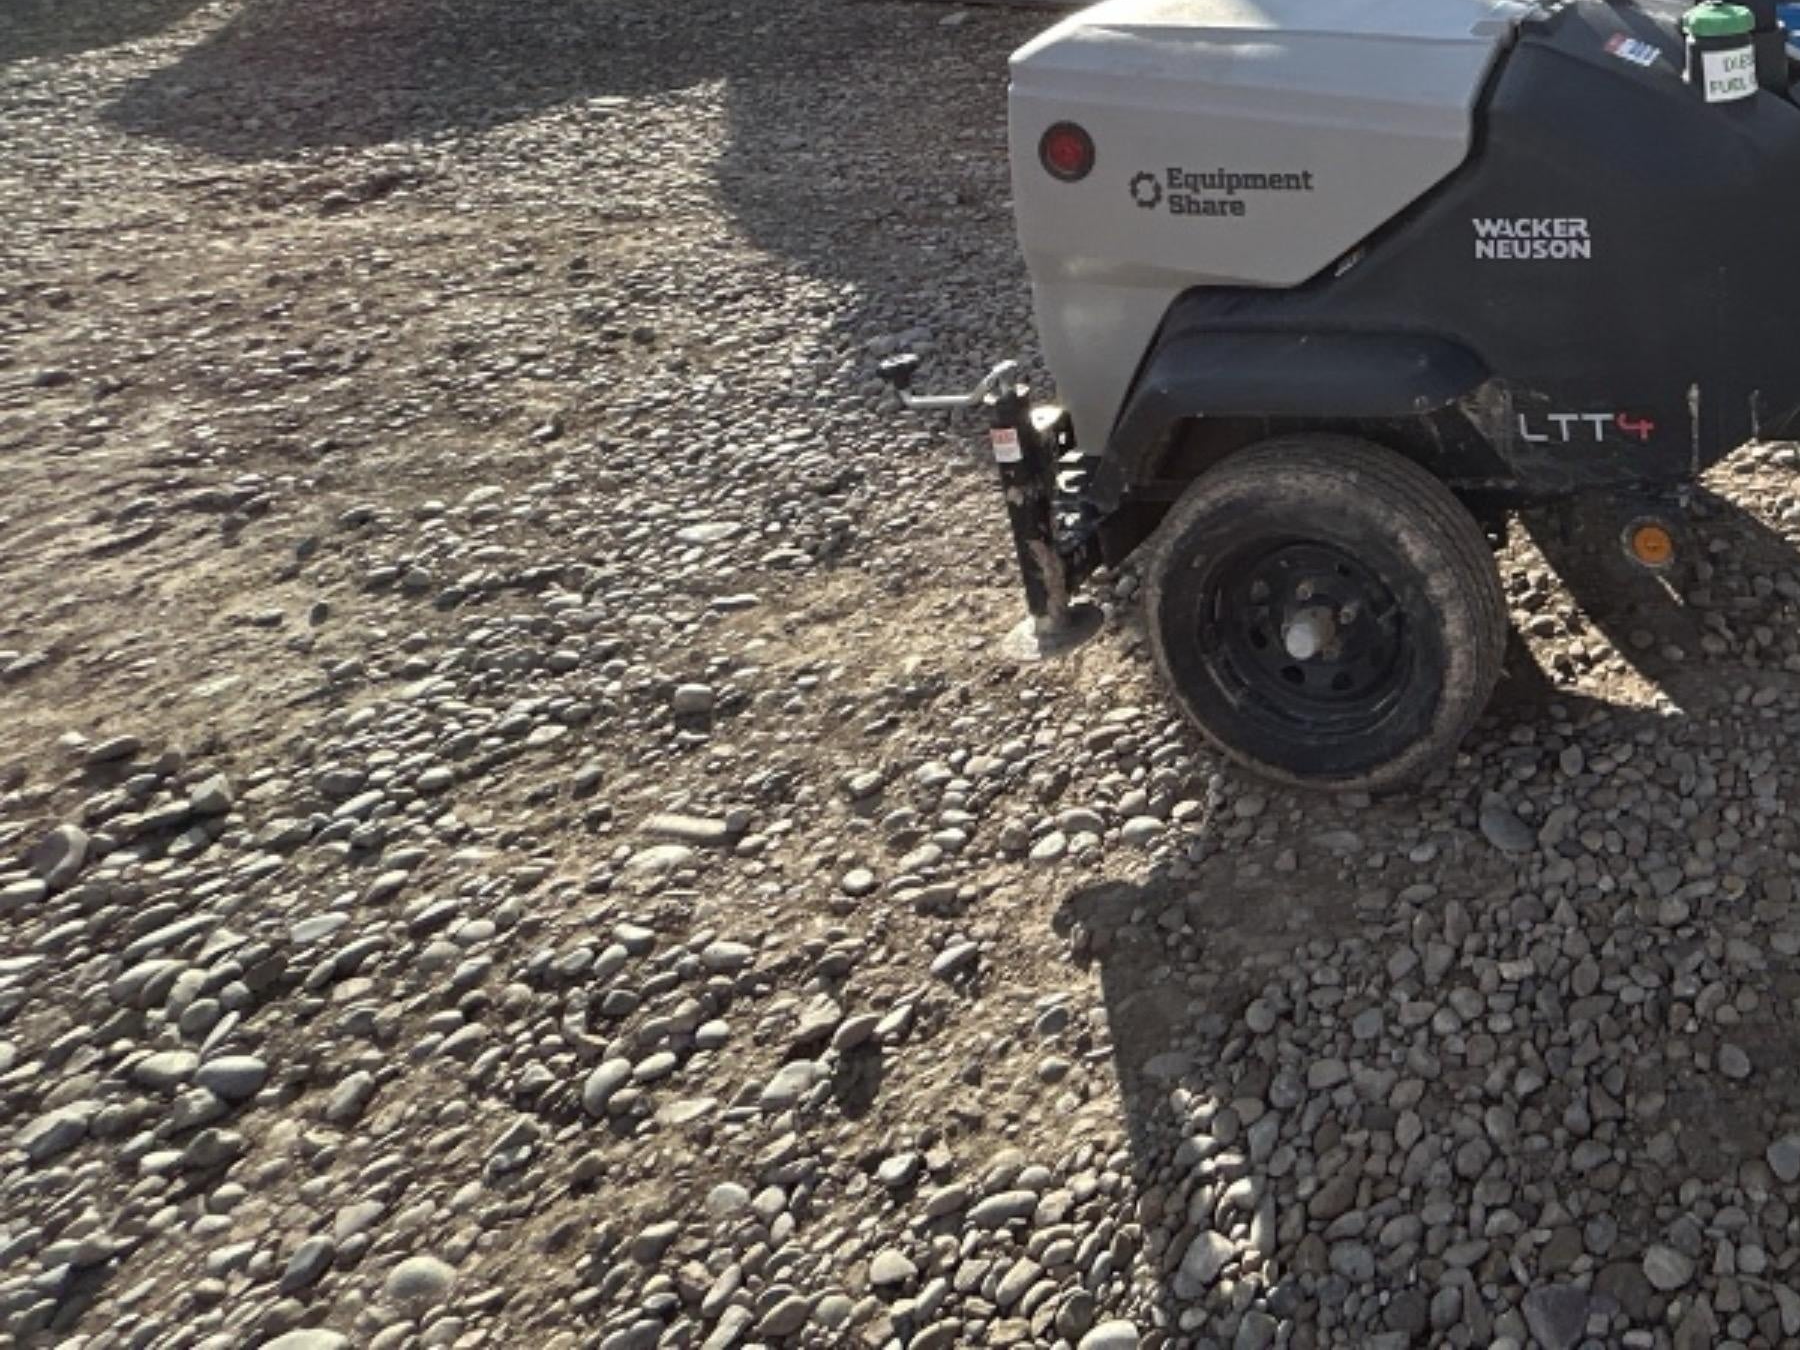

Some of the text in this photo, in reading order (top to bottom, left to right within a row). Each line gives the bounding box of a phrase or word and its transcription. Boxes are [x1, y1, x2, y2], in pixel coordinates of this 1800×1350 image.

[1166, 167, 1314, 195] Equipment
[1168, 194, 1246, 217] Share
[1472, 217, 1591, 238] WACKER
[1475, 239, 1592, 259] NEUSON
[1518, 412, 1655, 442] LTT4
